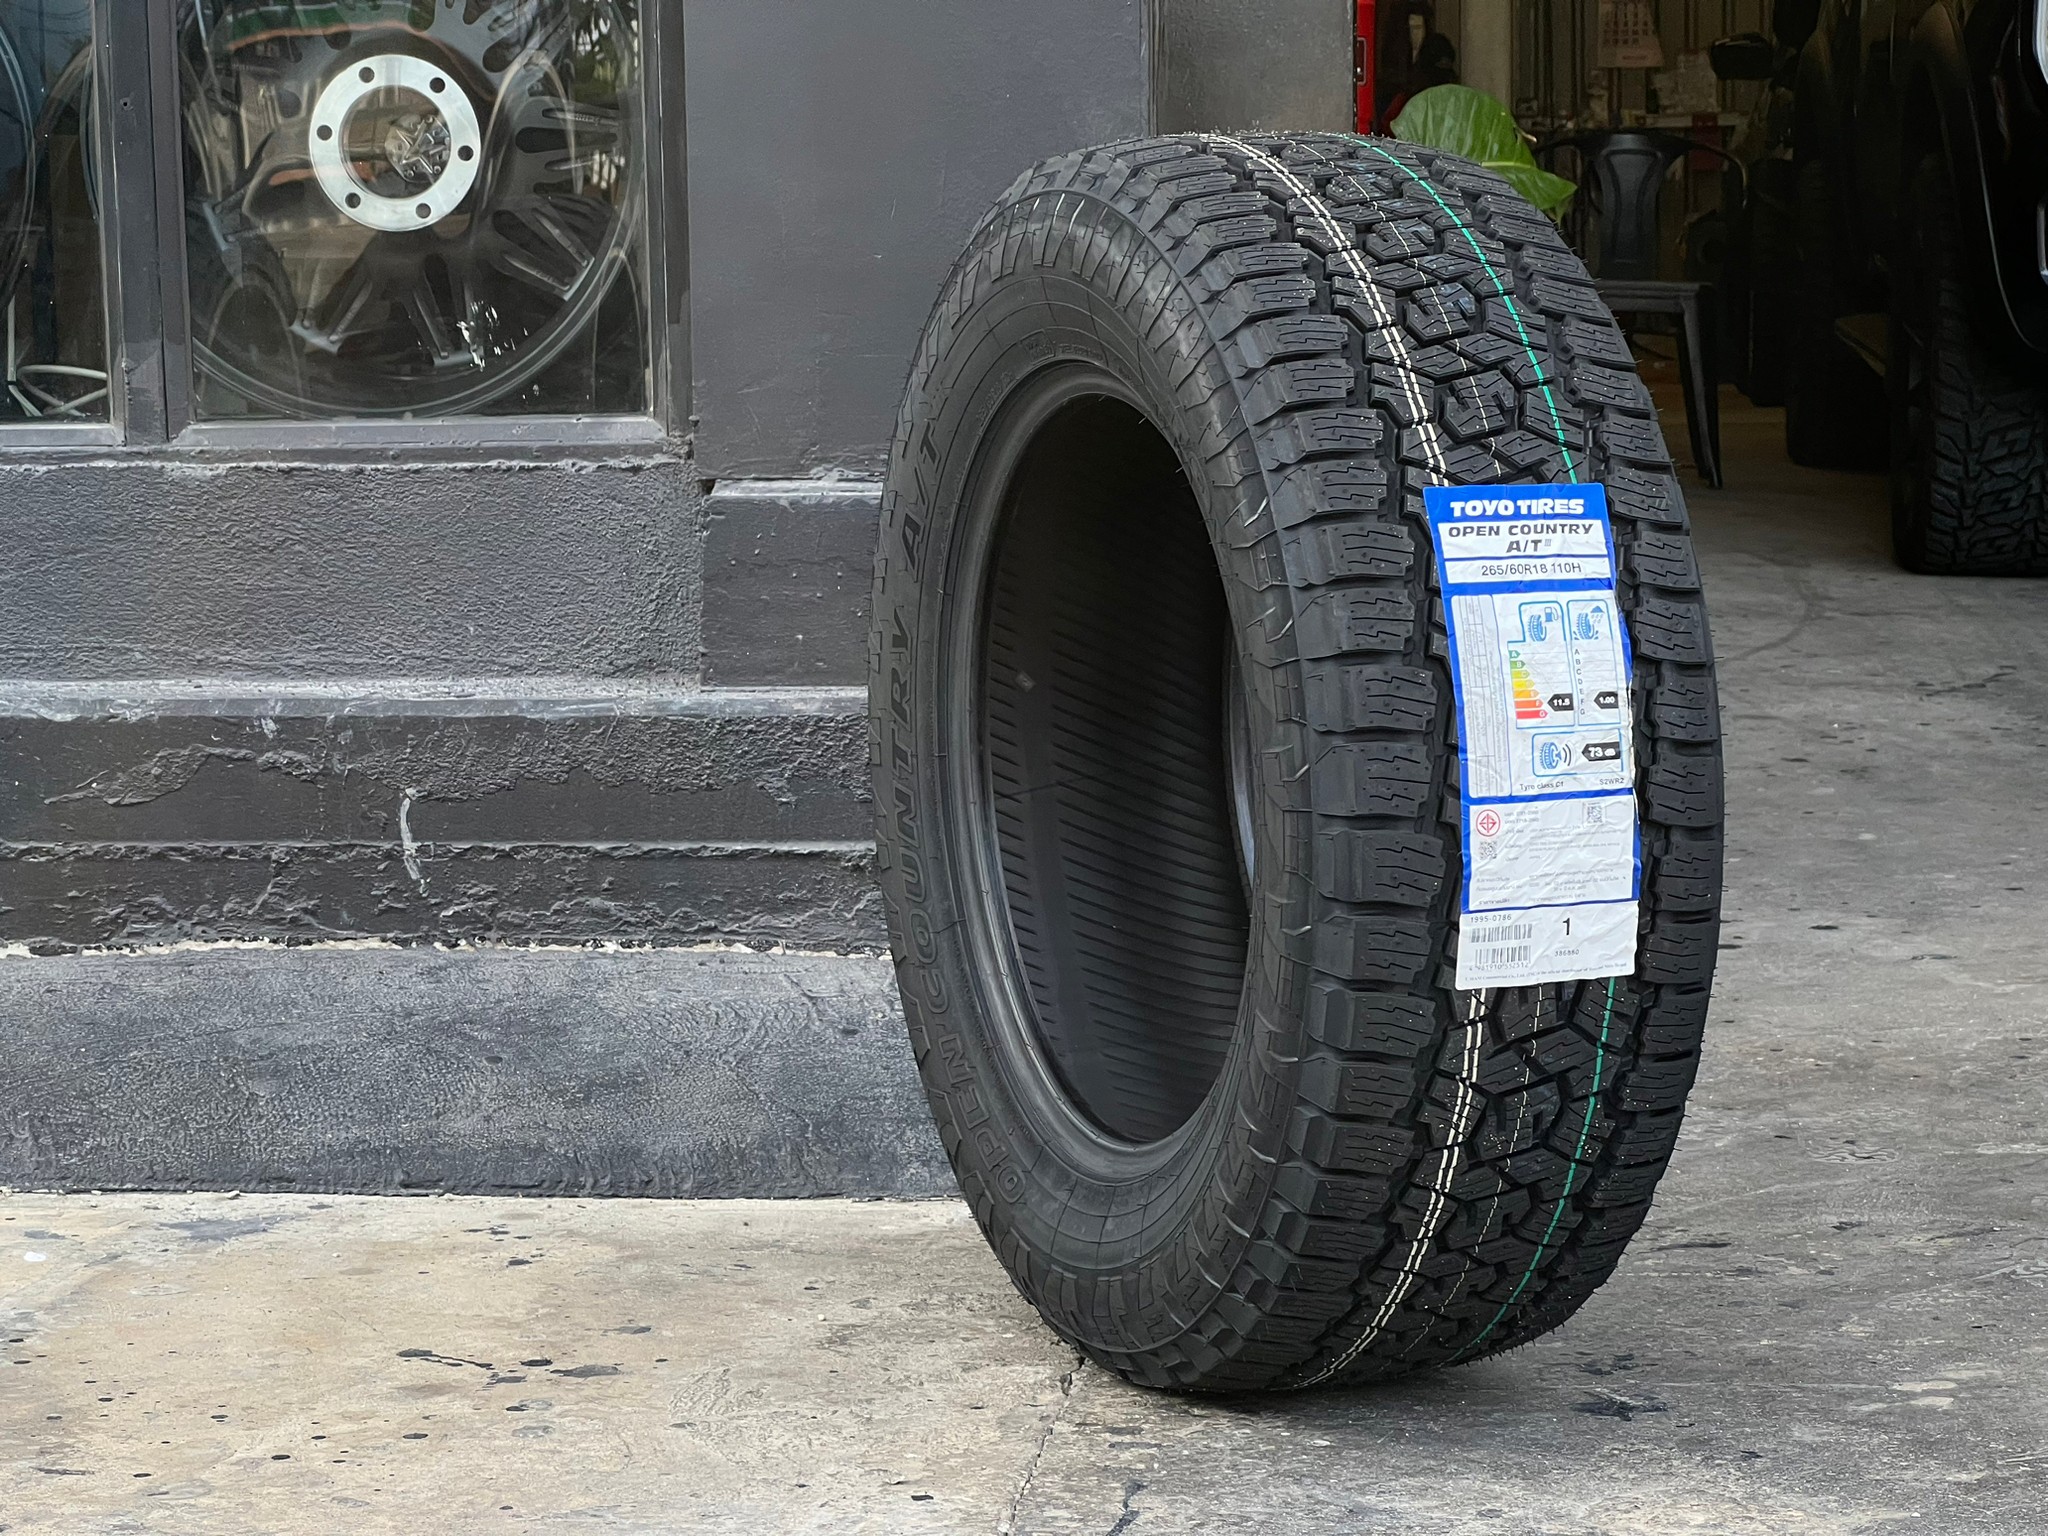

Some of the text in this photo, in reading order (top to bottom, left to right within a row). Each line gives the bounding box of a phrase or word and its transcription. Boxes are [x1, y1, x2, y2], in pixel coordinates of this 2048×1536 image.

[1450, 498, 1584, 517] TOYO TIRES
[1449, 523, 1593, 537] OPEN COUNTRY
[1481, 562, 1581, 576] 265/60R18 110H
[1511, 650, 1518, 658] A
[1588, 747, 1603, 757] 73
[891, 421, 1026, 1204] OPEN COUNTRY A/T
[1470, 914, 1512, 923] 1995-0786
[1562, 917, 1571, 936] 1
